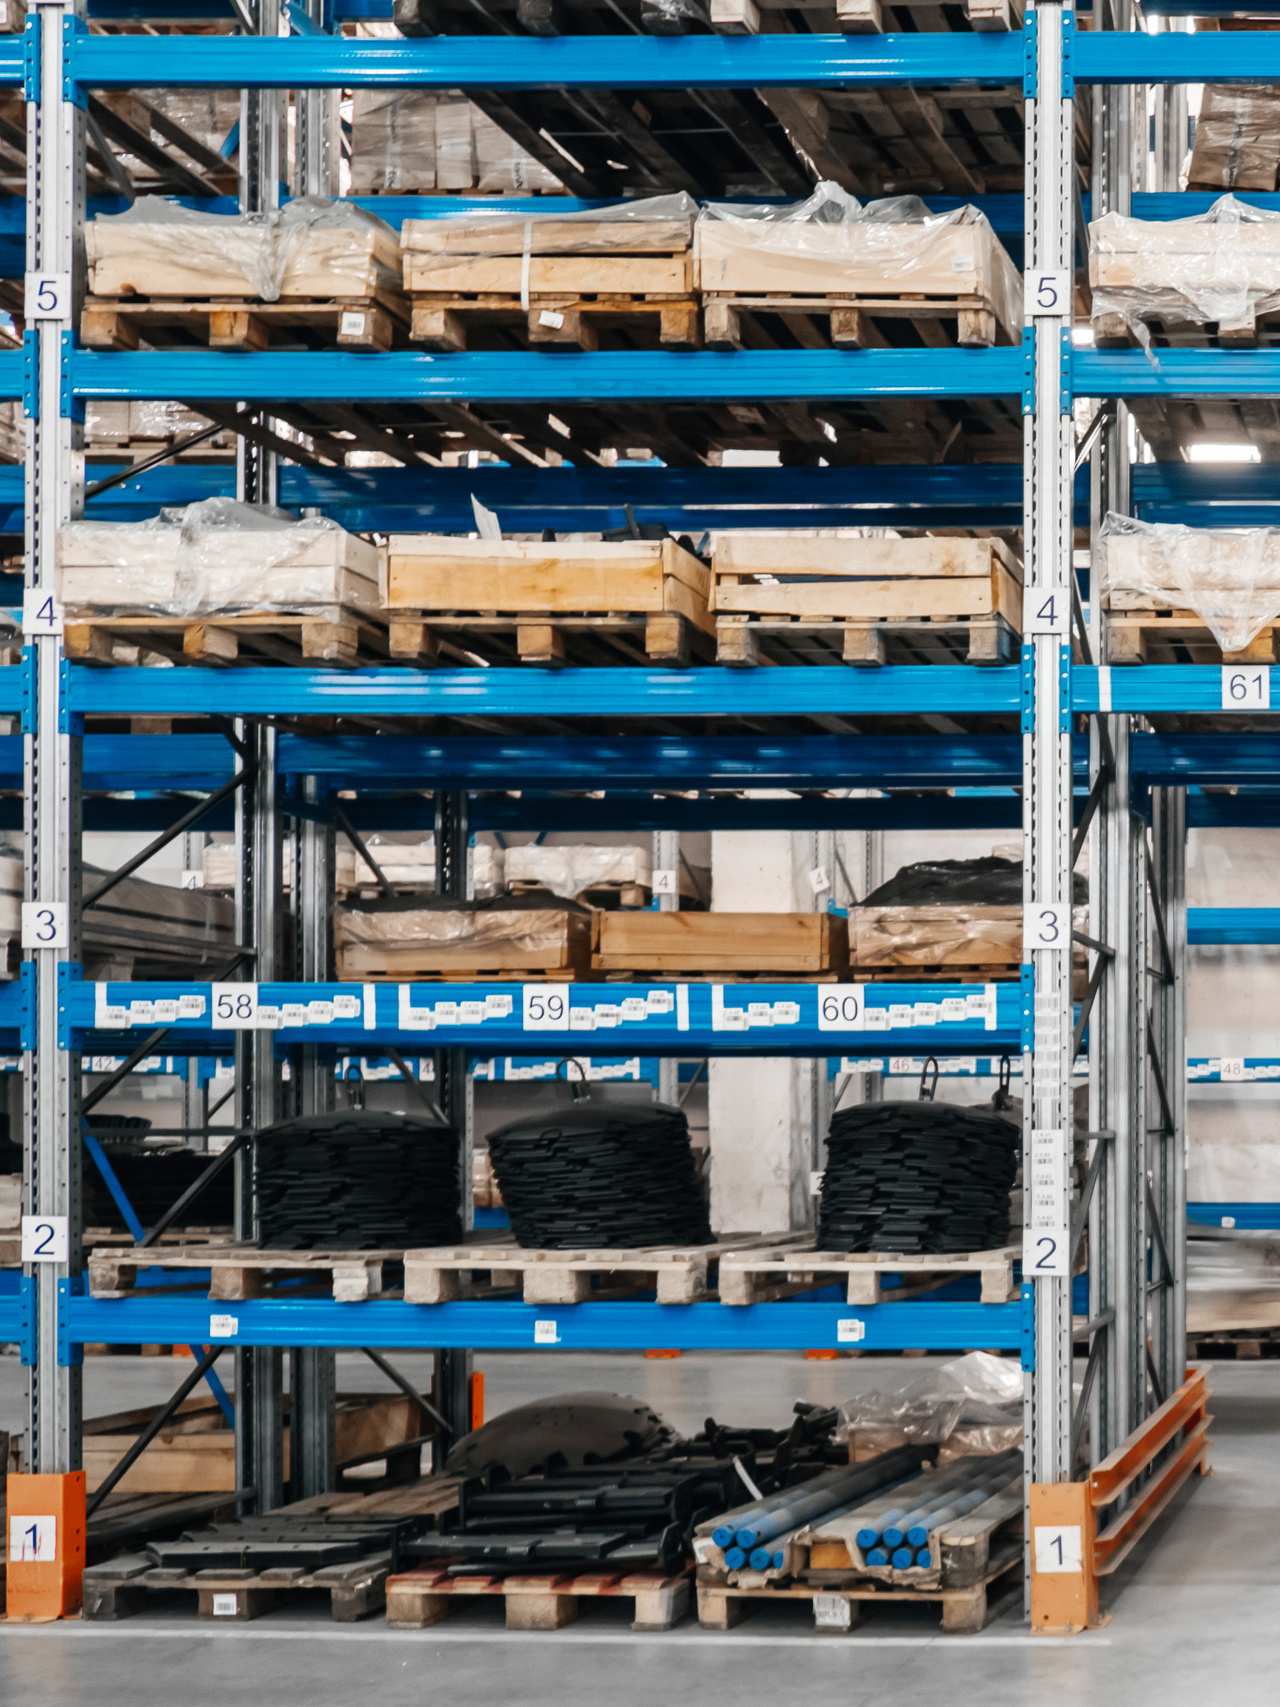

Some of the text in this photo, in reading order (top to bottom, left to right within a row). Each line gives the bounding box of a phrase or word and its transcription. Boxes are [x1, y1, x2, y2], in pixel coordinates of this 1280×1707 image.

[38, 281, 57, 311] 5
[1038, 277, 1057, 308] 5
[36, 597, 57, 626] 4
[1037, 595, 1058, 626] 4
[1230, 674, 1261, 699] 61
[658, 875, 668, 889] 4
[815, 872, 823, 886] 4
[37, 910, 56, 941] 3
[1039, 911, 1058, 942] 3
[218, 994, 252, 1018] 58
[530, 996, 563, 1020] 59
[823, 997, 858, 1021] 60
[94, 1057, 112, 1070] 42
[891, 1058, 910, 1072] 46
[1223, 1063, 1241, 1075] 48
[34, 1224, 54, 1254] 2
[1036, 1238, 1056, 1268] 2
[25, 1524, 37, 1554] 1
[1051, 1535, 1062, 1565] 1
